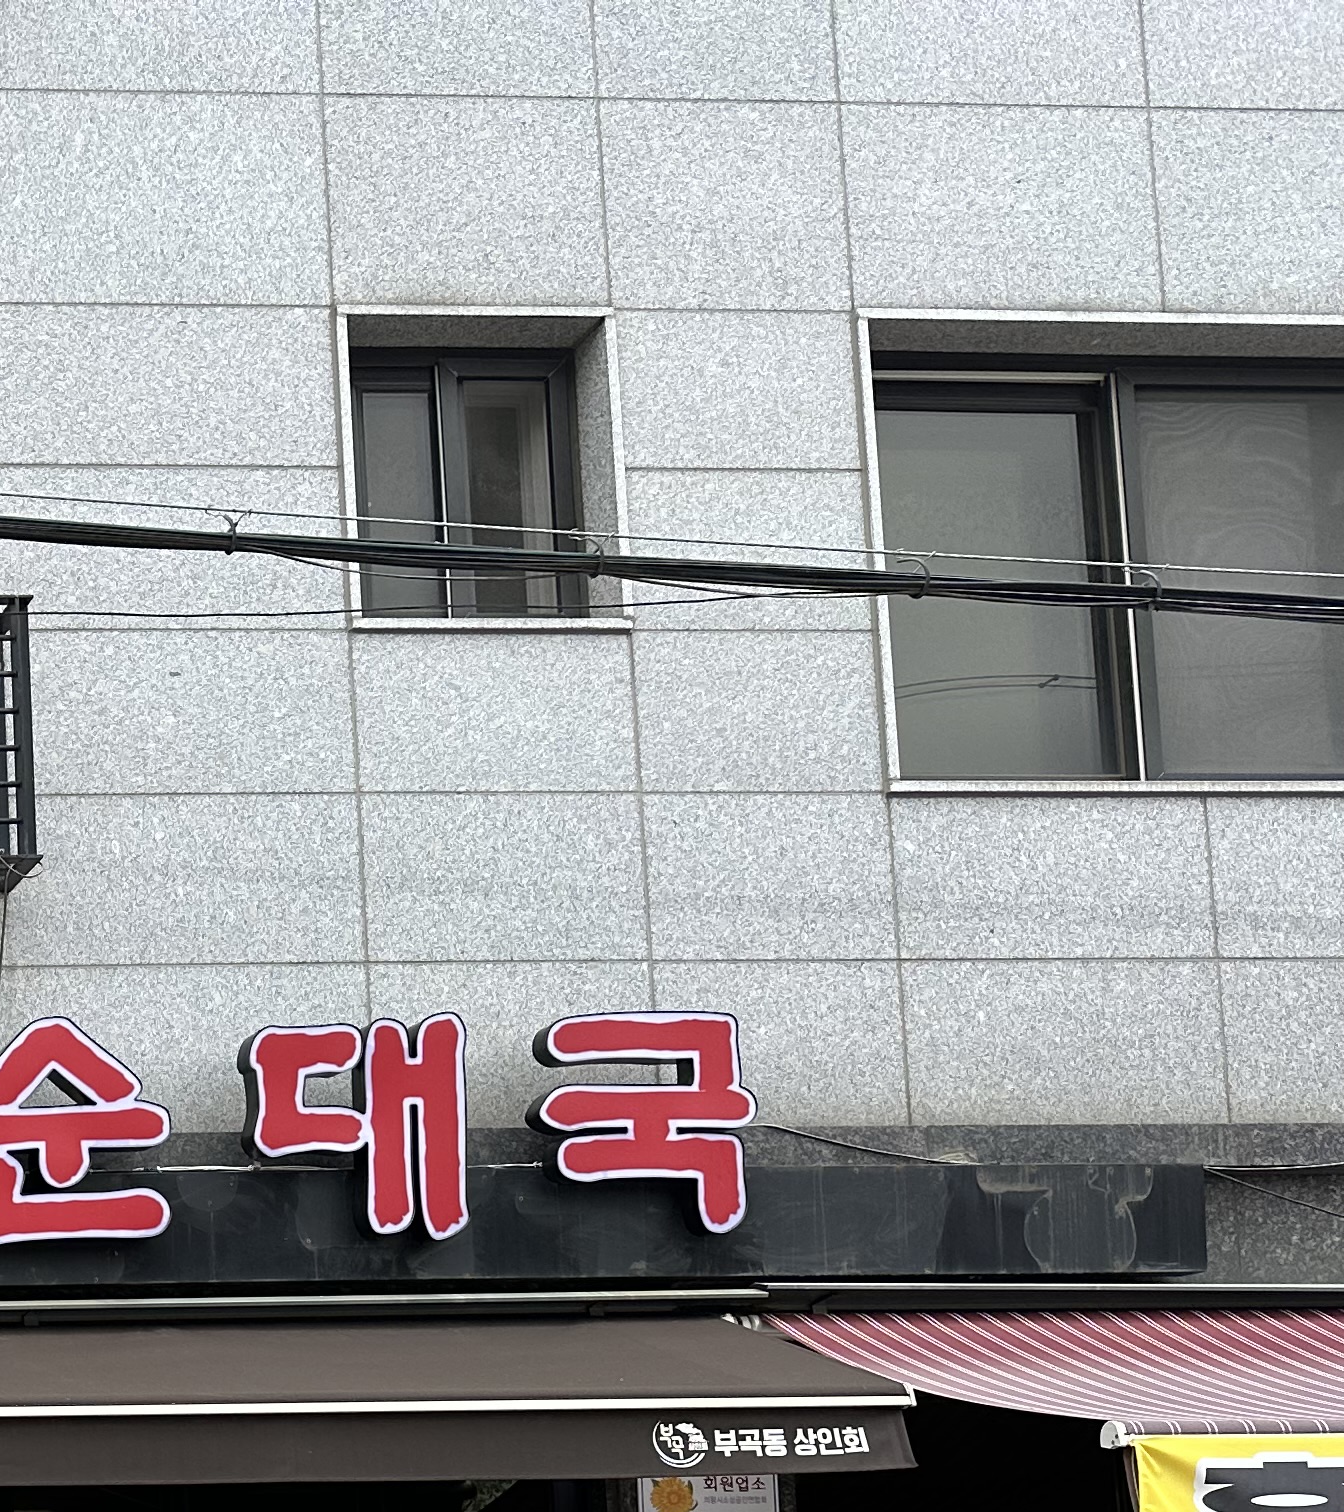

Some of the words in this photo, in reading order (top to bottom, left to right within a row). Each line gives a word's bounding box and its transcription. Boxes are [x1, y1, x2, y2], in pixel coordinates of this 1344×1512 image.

[713, 1427, 789, 1459] 부곡동
[793, 1425, 870, 1457] 상인회
[703, 1475, 767, 1492] 회원업소
